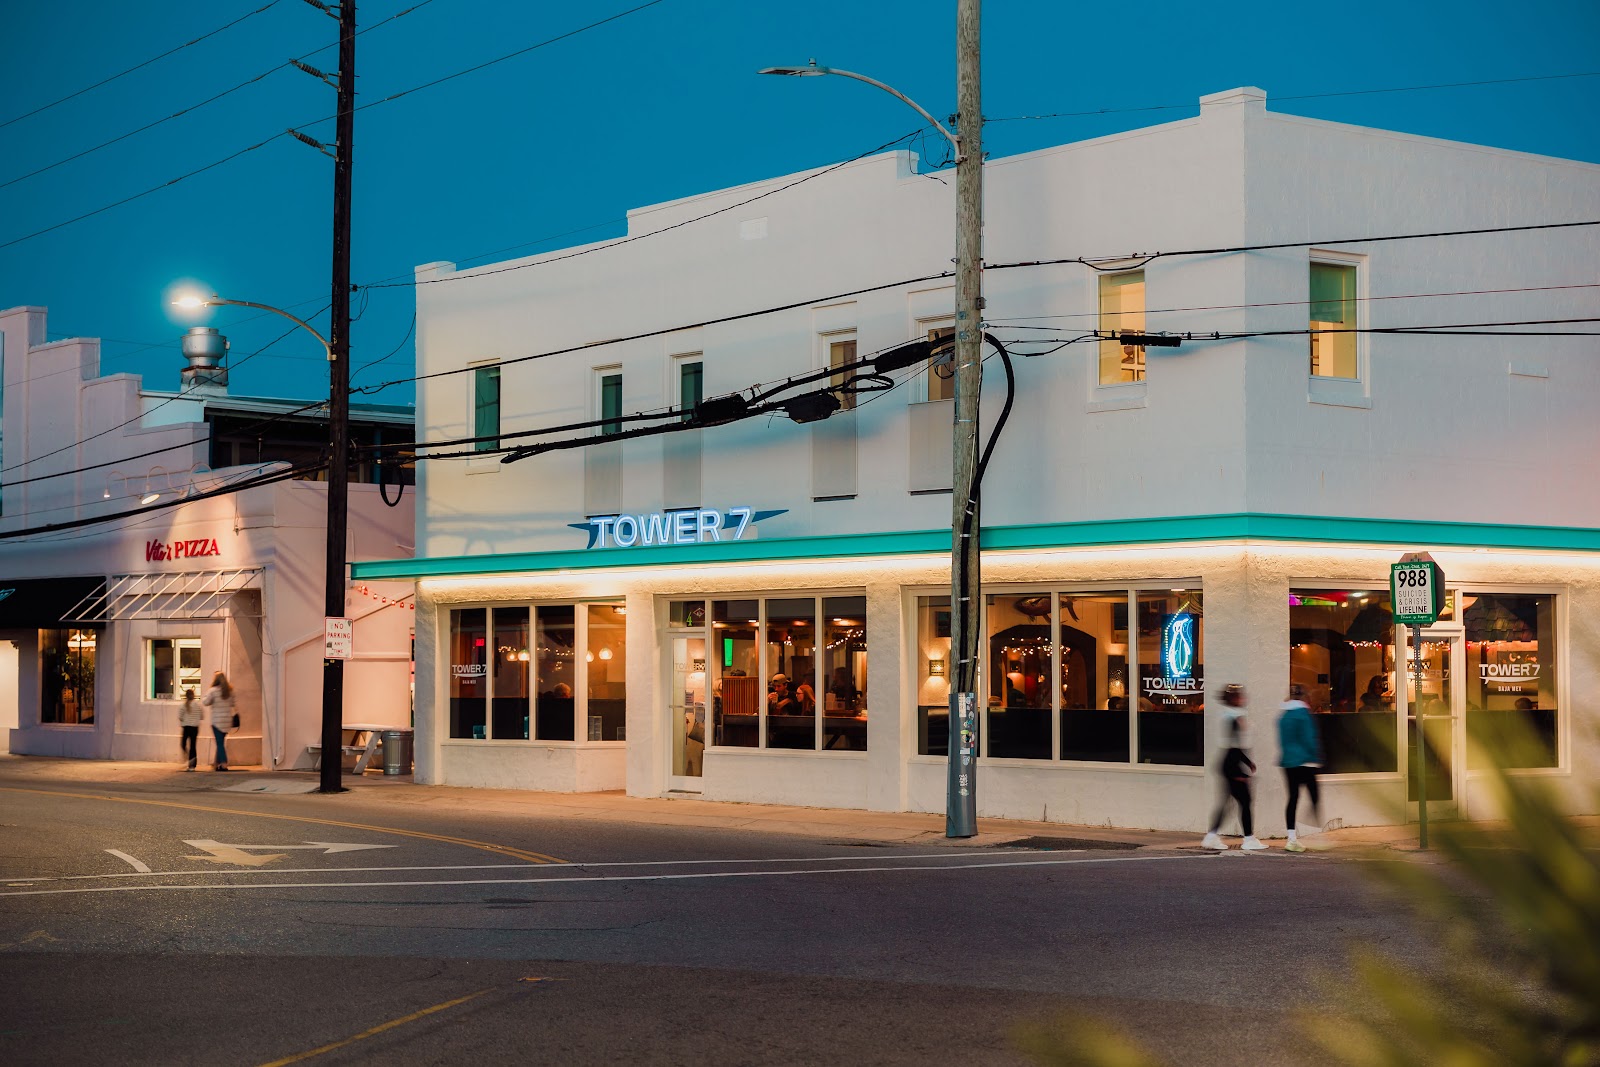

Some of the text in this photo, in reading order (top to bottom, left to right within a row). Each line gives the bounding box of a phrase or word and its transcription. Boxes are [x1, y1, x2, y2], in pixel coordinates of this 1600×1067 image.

[590, 506, 753, 547] TOWER 7
[146, 539, 220, 561] Vito's PIZZA
[1398, 570, 1426, 587] 988
[452, 664, 487, 673] TOWER 7
[1444, 669, 1449, 678] 7
[1478, 663, 1540, 676] TOWER 7
[1143, 677, 1205, 689] TOWER 7
